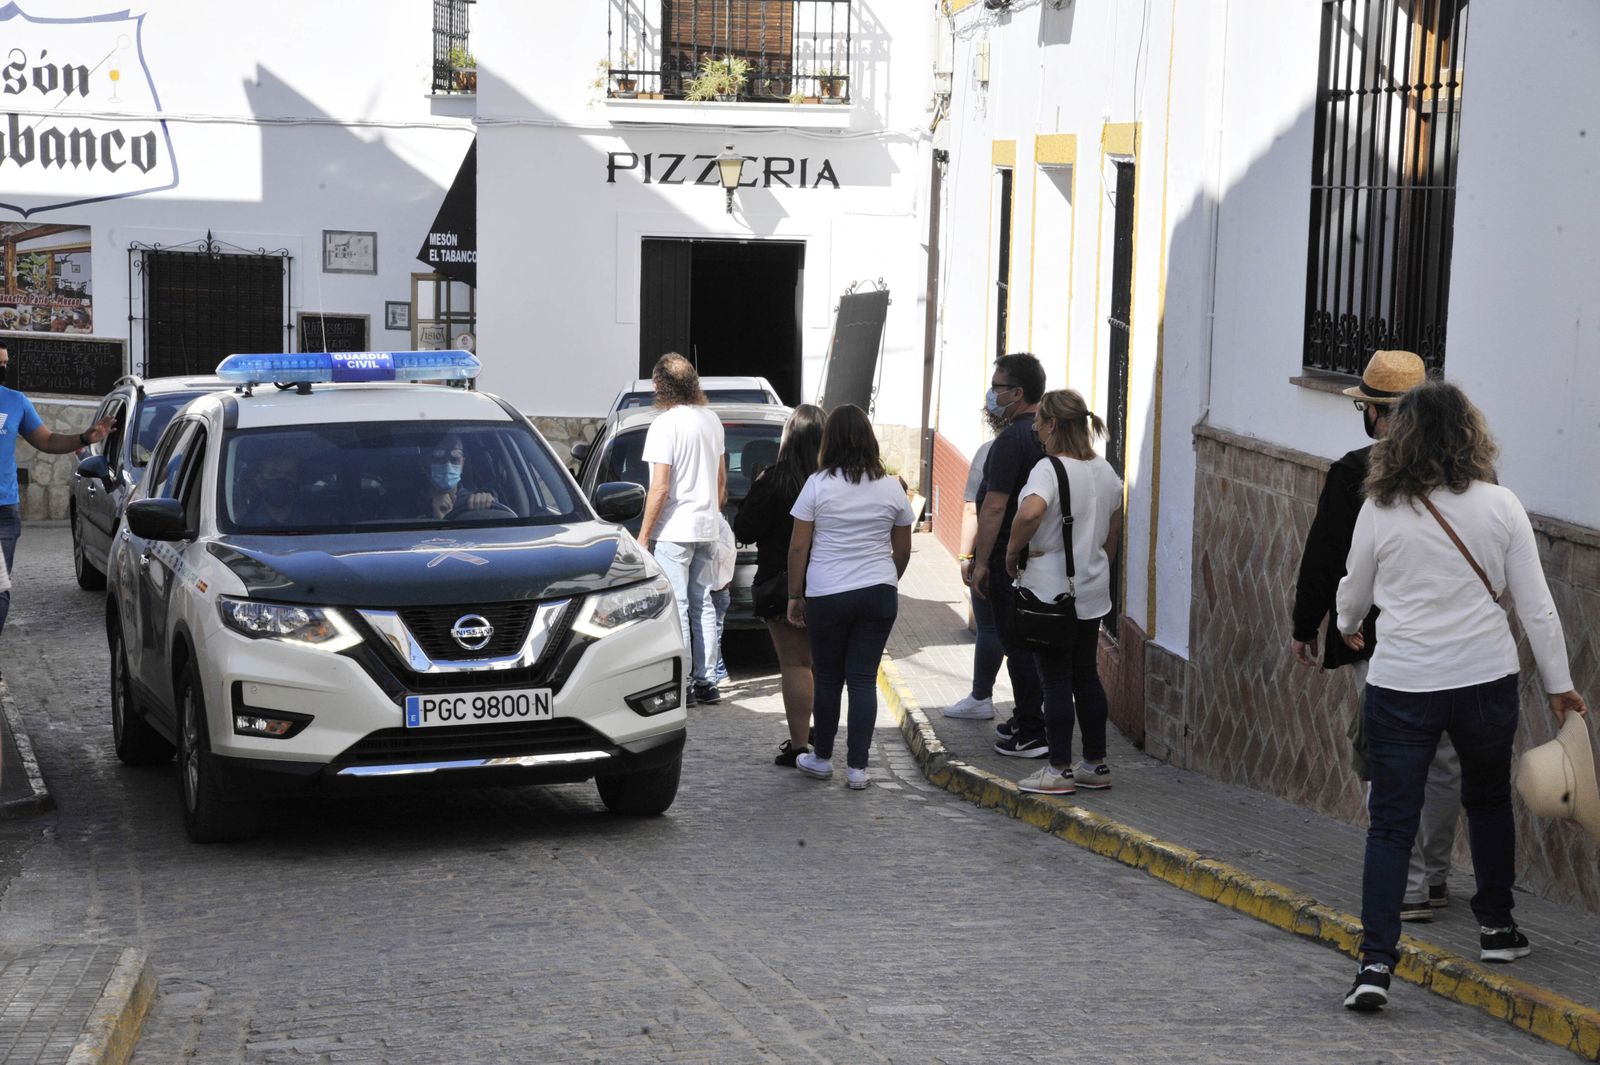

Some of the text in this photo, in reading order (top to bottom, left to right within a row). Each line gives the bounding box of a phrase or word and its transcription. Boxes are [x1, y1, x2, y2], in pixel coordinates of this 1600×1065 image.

[0, 113, 157, 174] banco
[429, 231, 458, 246] MESÓN
[429, 249, 477, 263] EL TABANCO
[334, 353, 389, 361] GUARDIA
[347, 360, 380, 369] CIVIL
[455, 626, 493, 637] NISSAN
[410, 692, 549, 722] E PGC 9800 N
